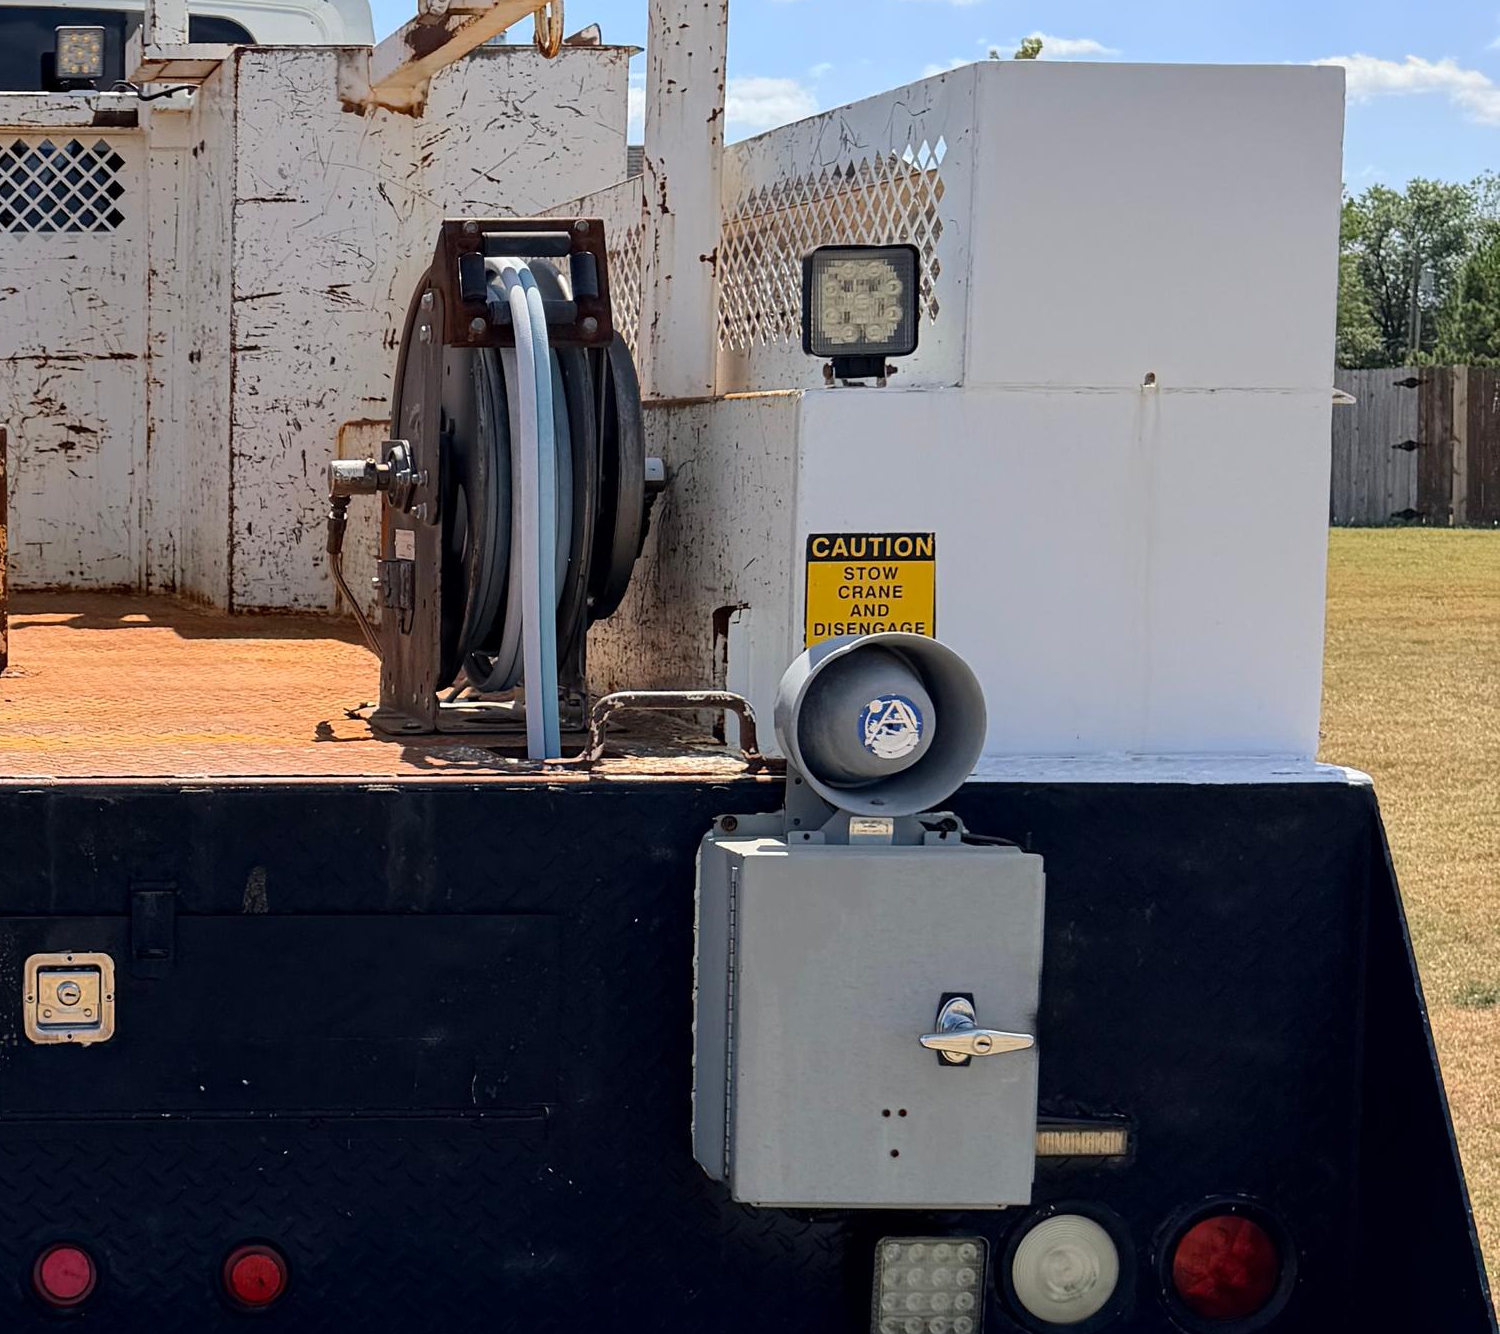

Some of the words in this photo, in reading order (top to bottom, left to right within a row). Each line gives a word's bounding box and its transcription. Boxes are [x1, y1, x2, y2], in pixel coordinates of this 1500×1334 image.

[811, 536, 933, 558] CAUTION
[843, 566, 899, 581] STOW
[837, 585, 904, 599] CRANE
[850, 604, 890, 618] AND
[814, 622, 926, 636] DISENGAGE
